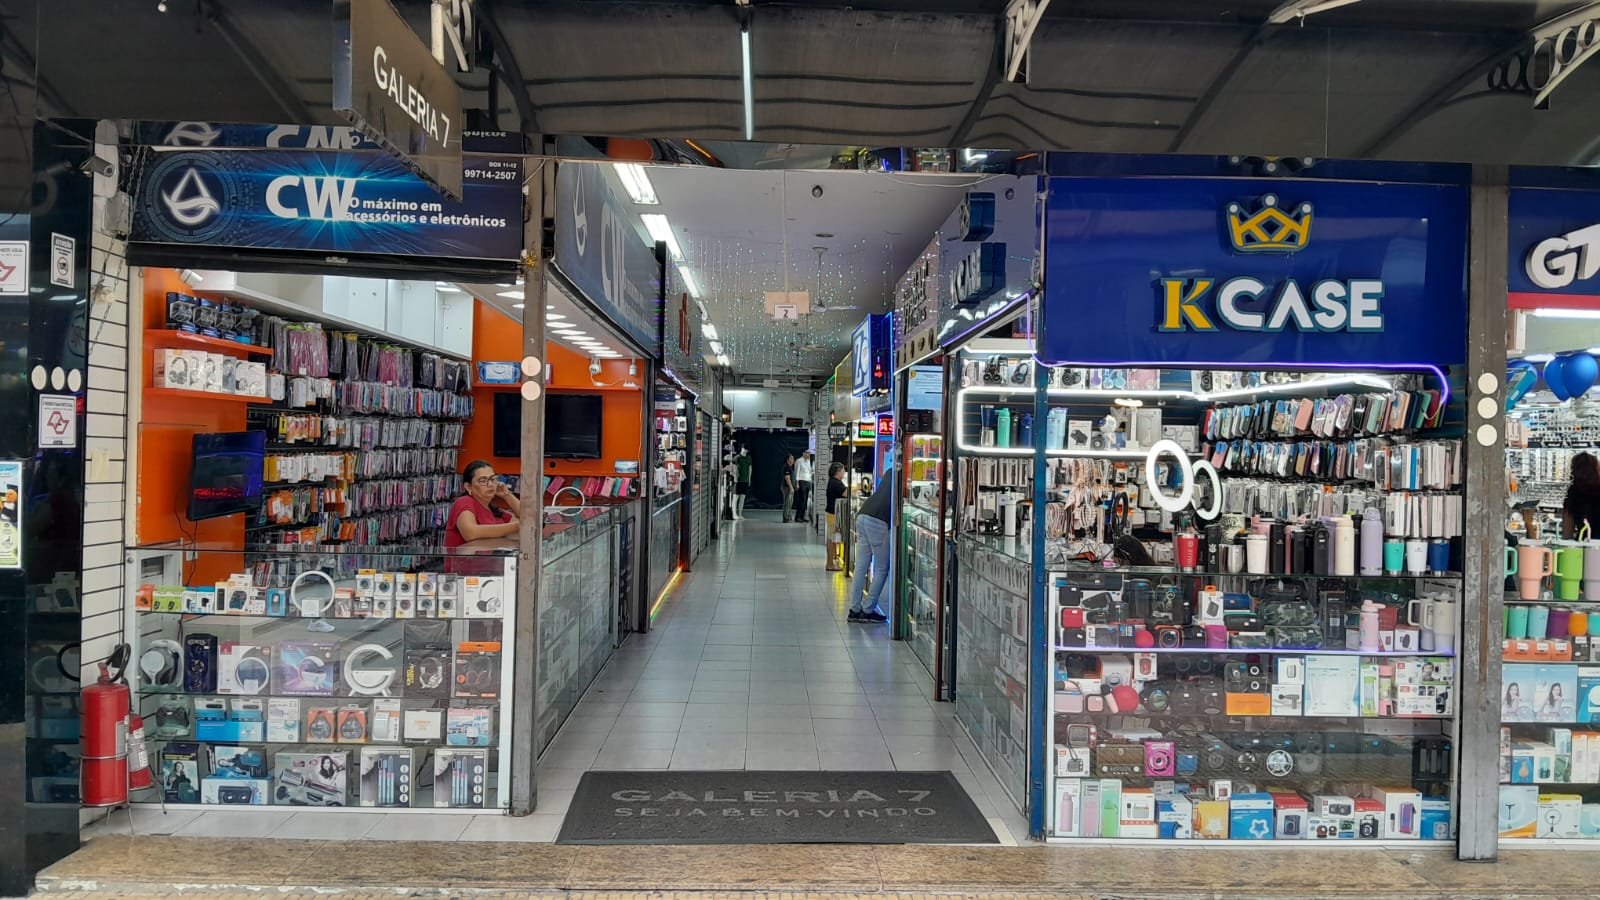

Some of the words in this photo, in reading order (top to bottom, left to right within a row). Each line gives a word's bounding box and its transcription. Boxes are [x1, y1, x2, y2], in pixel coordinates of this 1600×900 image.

[373, 45, 438, 141] GALERIA
[441, 112, 450, 148] 7
[464, 169, 517, 180] 99714-2507
[265, 174, 358, 222] CW
[350, 197, 359, 208] O
[362, 196, 418, 211] máximo
[420, 201, 442, 212] em
[346, 209, 416, 224] acessórios
[419, 214, 428, 224] e
[430, 212, 506, 228] eletrônicos
[783, 310, 789, 318] 2
[611, 789, 886, 802] GALERIA
[898, 790, 931, 802] 7
[614, 807, 707, 817] SEJA
